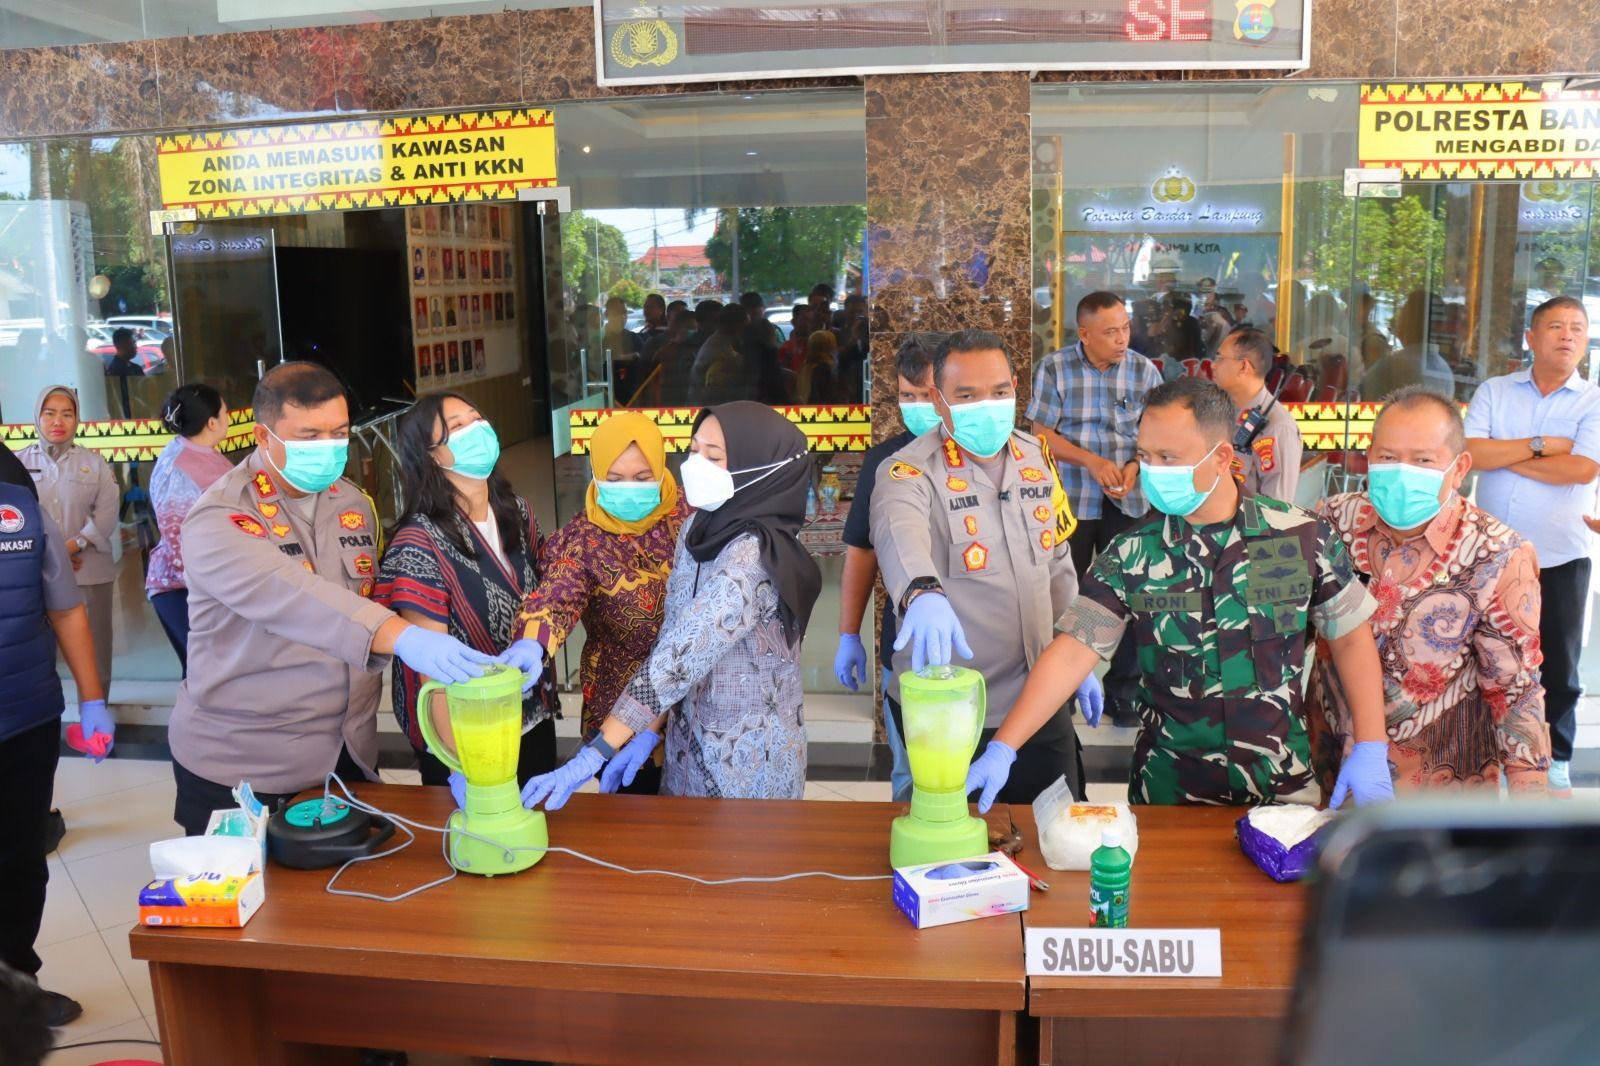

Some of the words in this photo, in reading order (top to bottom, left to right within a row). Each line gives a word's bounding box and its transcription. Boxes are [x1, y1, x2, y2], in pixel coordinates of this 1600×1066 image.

[1126, 0, 1208, 41] SE
[1374, 109, 1529, 132] POLRESTA
[1539, 108, 1600, 130] BAN
[202, 153, 260, 173] ANDA
[266, 143, 384, 168] MEMASUKI
[391, 136, 505, 159] KAWASAN
[1435, 139, 1564, 154] MENGABDI
[188, 177, 247, 196] ZONA
[253, 167, 382, 191] INTEGRITAS
[390, 165, 406, 181] &
[413, 161, 466, 179] ANTI
[474, 157, 524, 176] KKN
[1081, 207, 1135, 222] Polresta
[1141, 206, 1193, 221] Bandar
[1199, 204, 1265, 225] Lampung
[1020, 486, 1053, 499] POLRI
[339, 534, 374, 548] POLRI
[1143, 596, 1187, 609] RONI
[1254, 586, 1282, 600] TNI
[1288, 584, 1308, 597] AD
[1042, 936, 1195, 974] SABU-SABU
